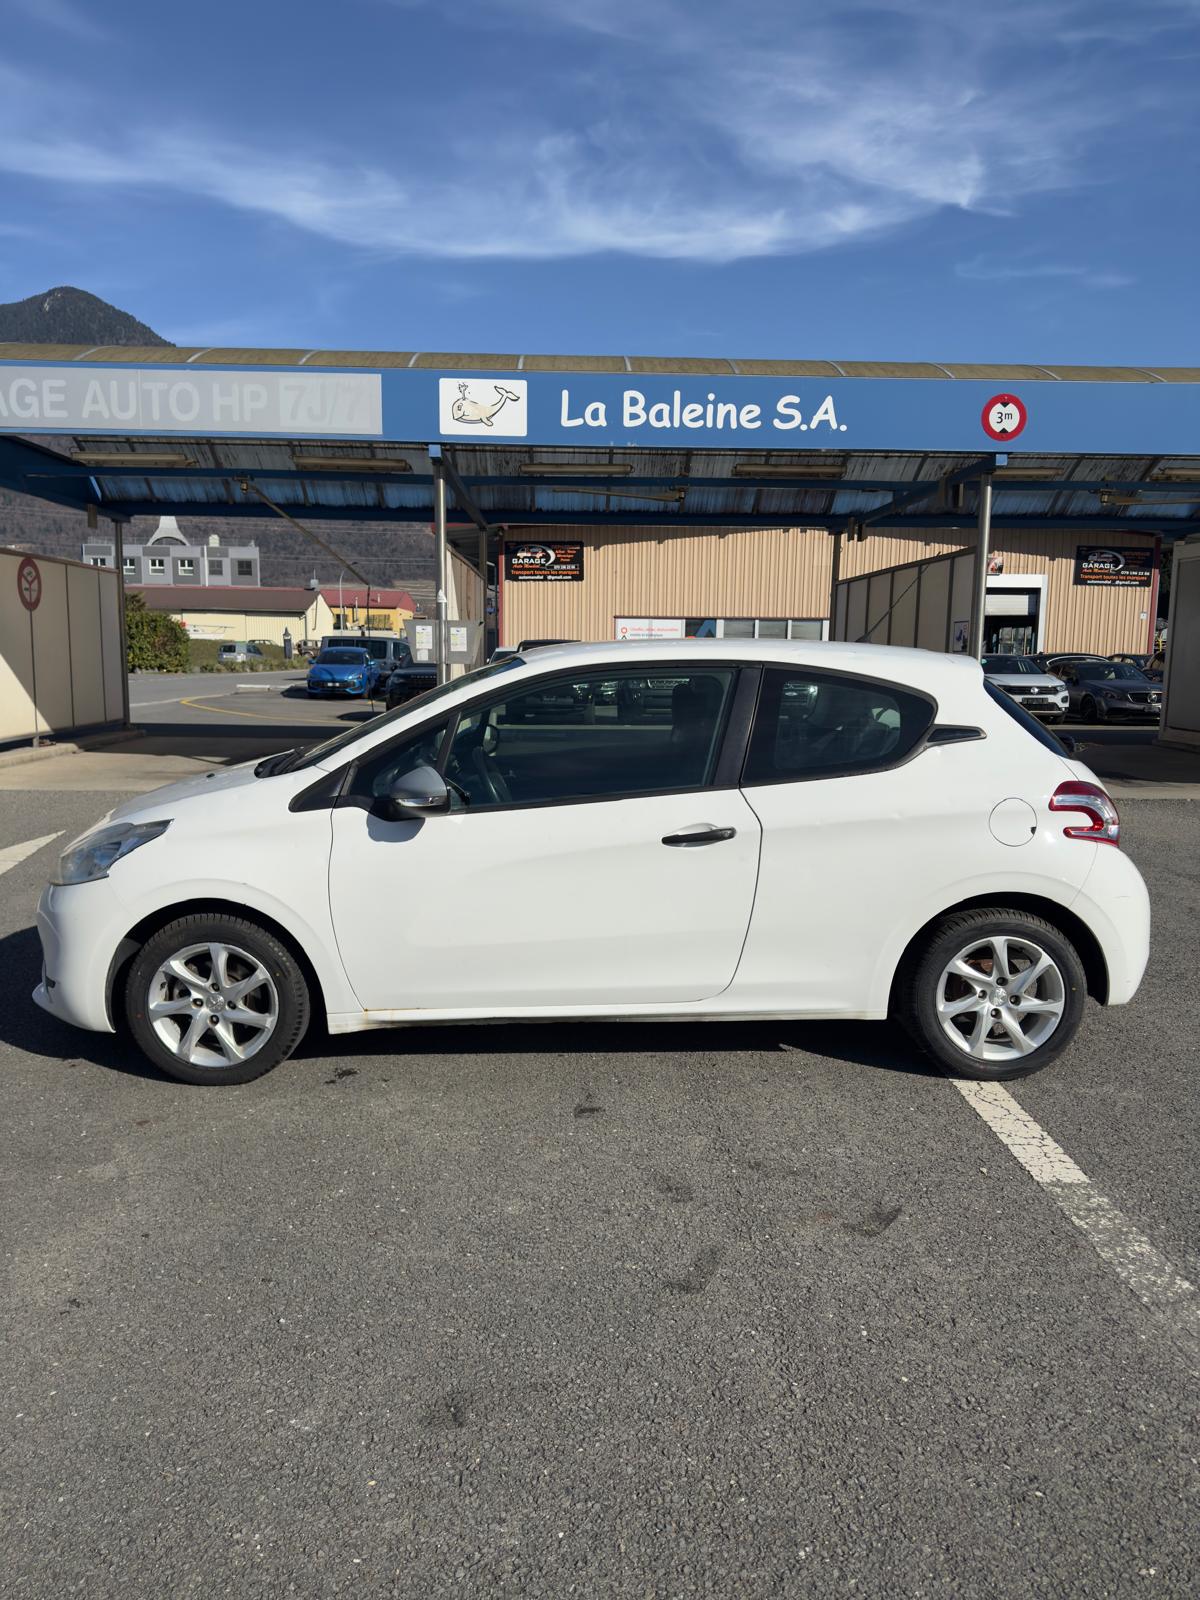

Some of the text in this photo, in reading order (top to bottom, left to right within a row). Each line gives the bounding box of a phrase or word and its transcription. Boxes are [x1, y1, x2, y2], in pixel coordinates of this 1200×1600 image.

[81, 380, 201, 422] AUTO
[212, 382, 268, 423] HP
[560, 389, 848, 431] La Baleine S.A.
